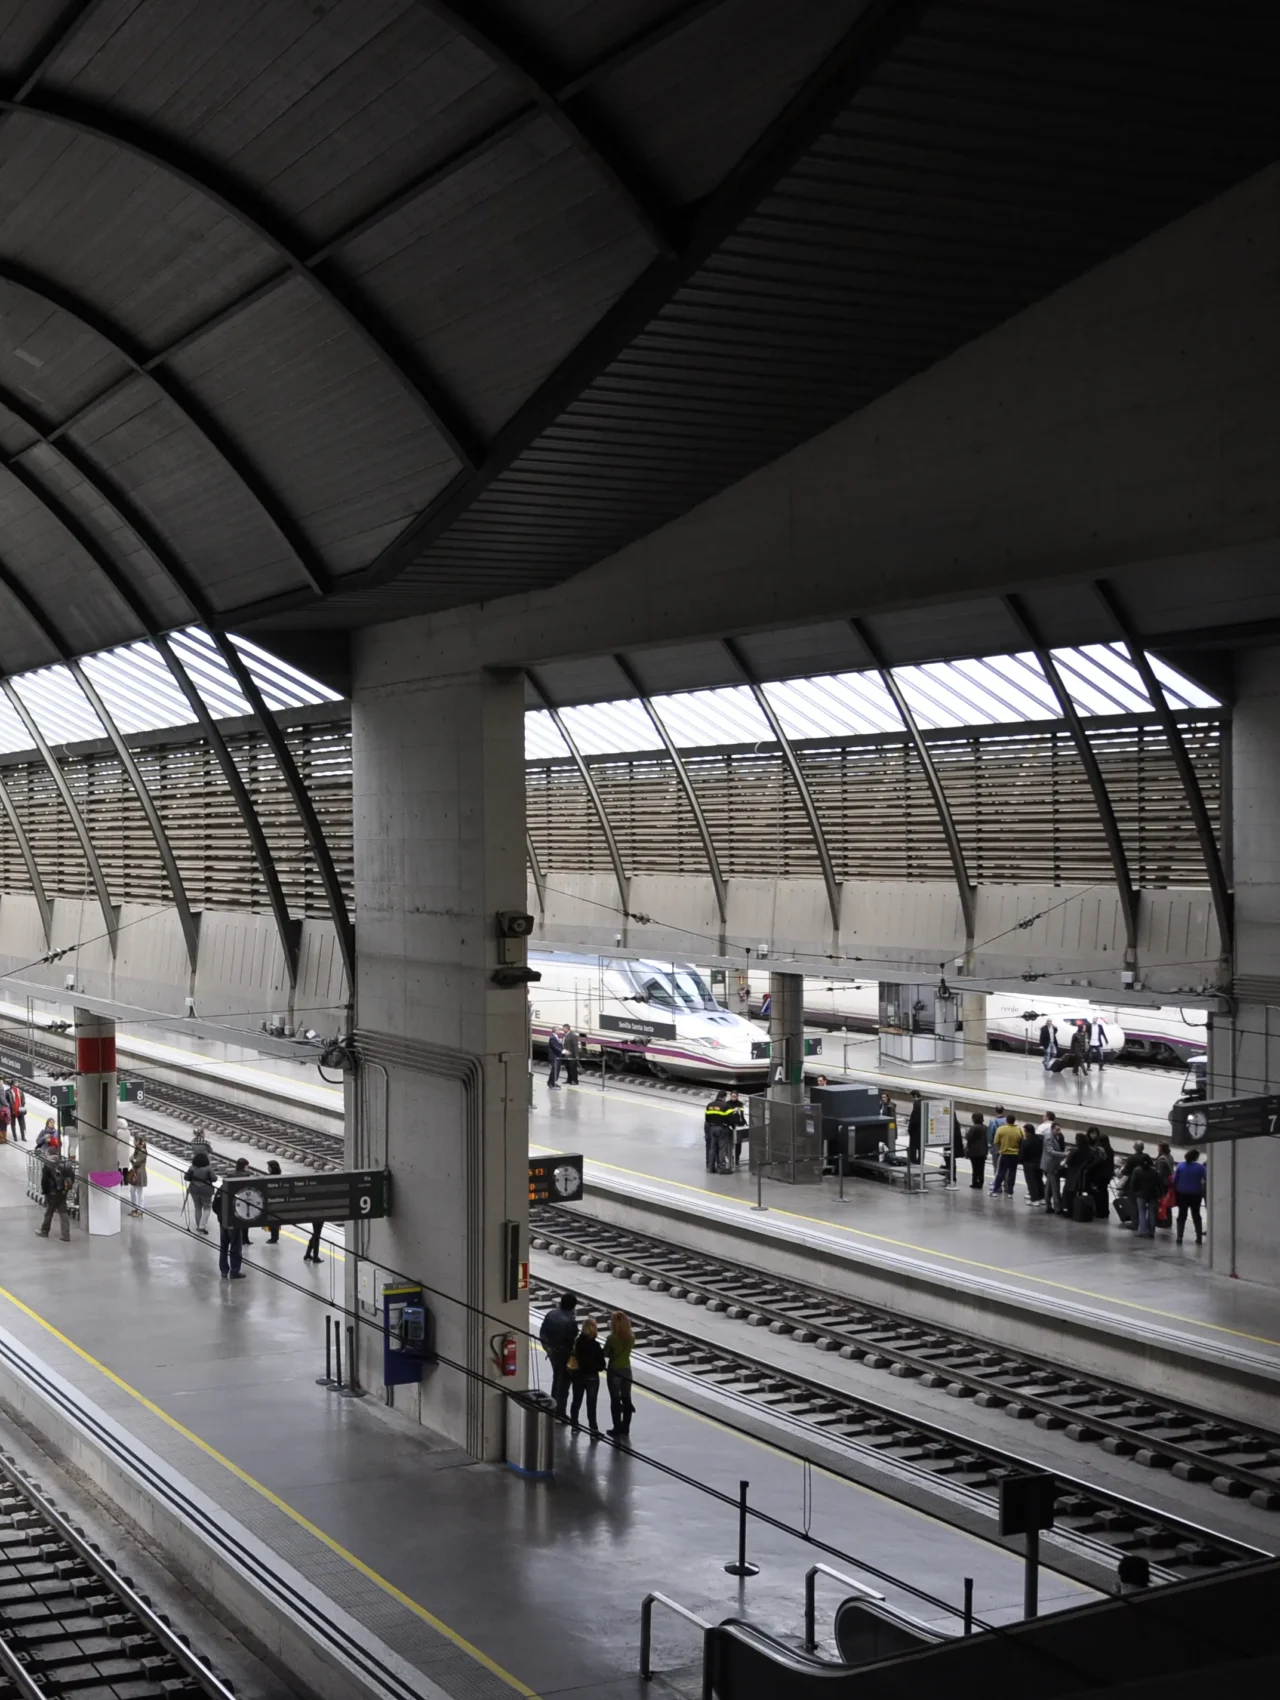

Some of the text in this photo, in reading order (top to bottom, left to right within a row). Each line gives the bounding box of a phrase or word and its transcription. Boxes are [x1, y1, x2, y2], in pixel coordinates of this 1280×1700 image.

[817, 1046, 822, 1054] 6
[753, 1051, 757, 1059] 7
[774, 1066, 785, 1082] A
[51, 1096, 58, 1104] 9
[137, 1091, 143, 1100] 8
[1268, 1115, 1277, 1132] 7
[360, 1196, 371, 1214] 9
